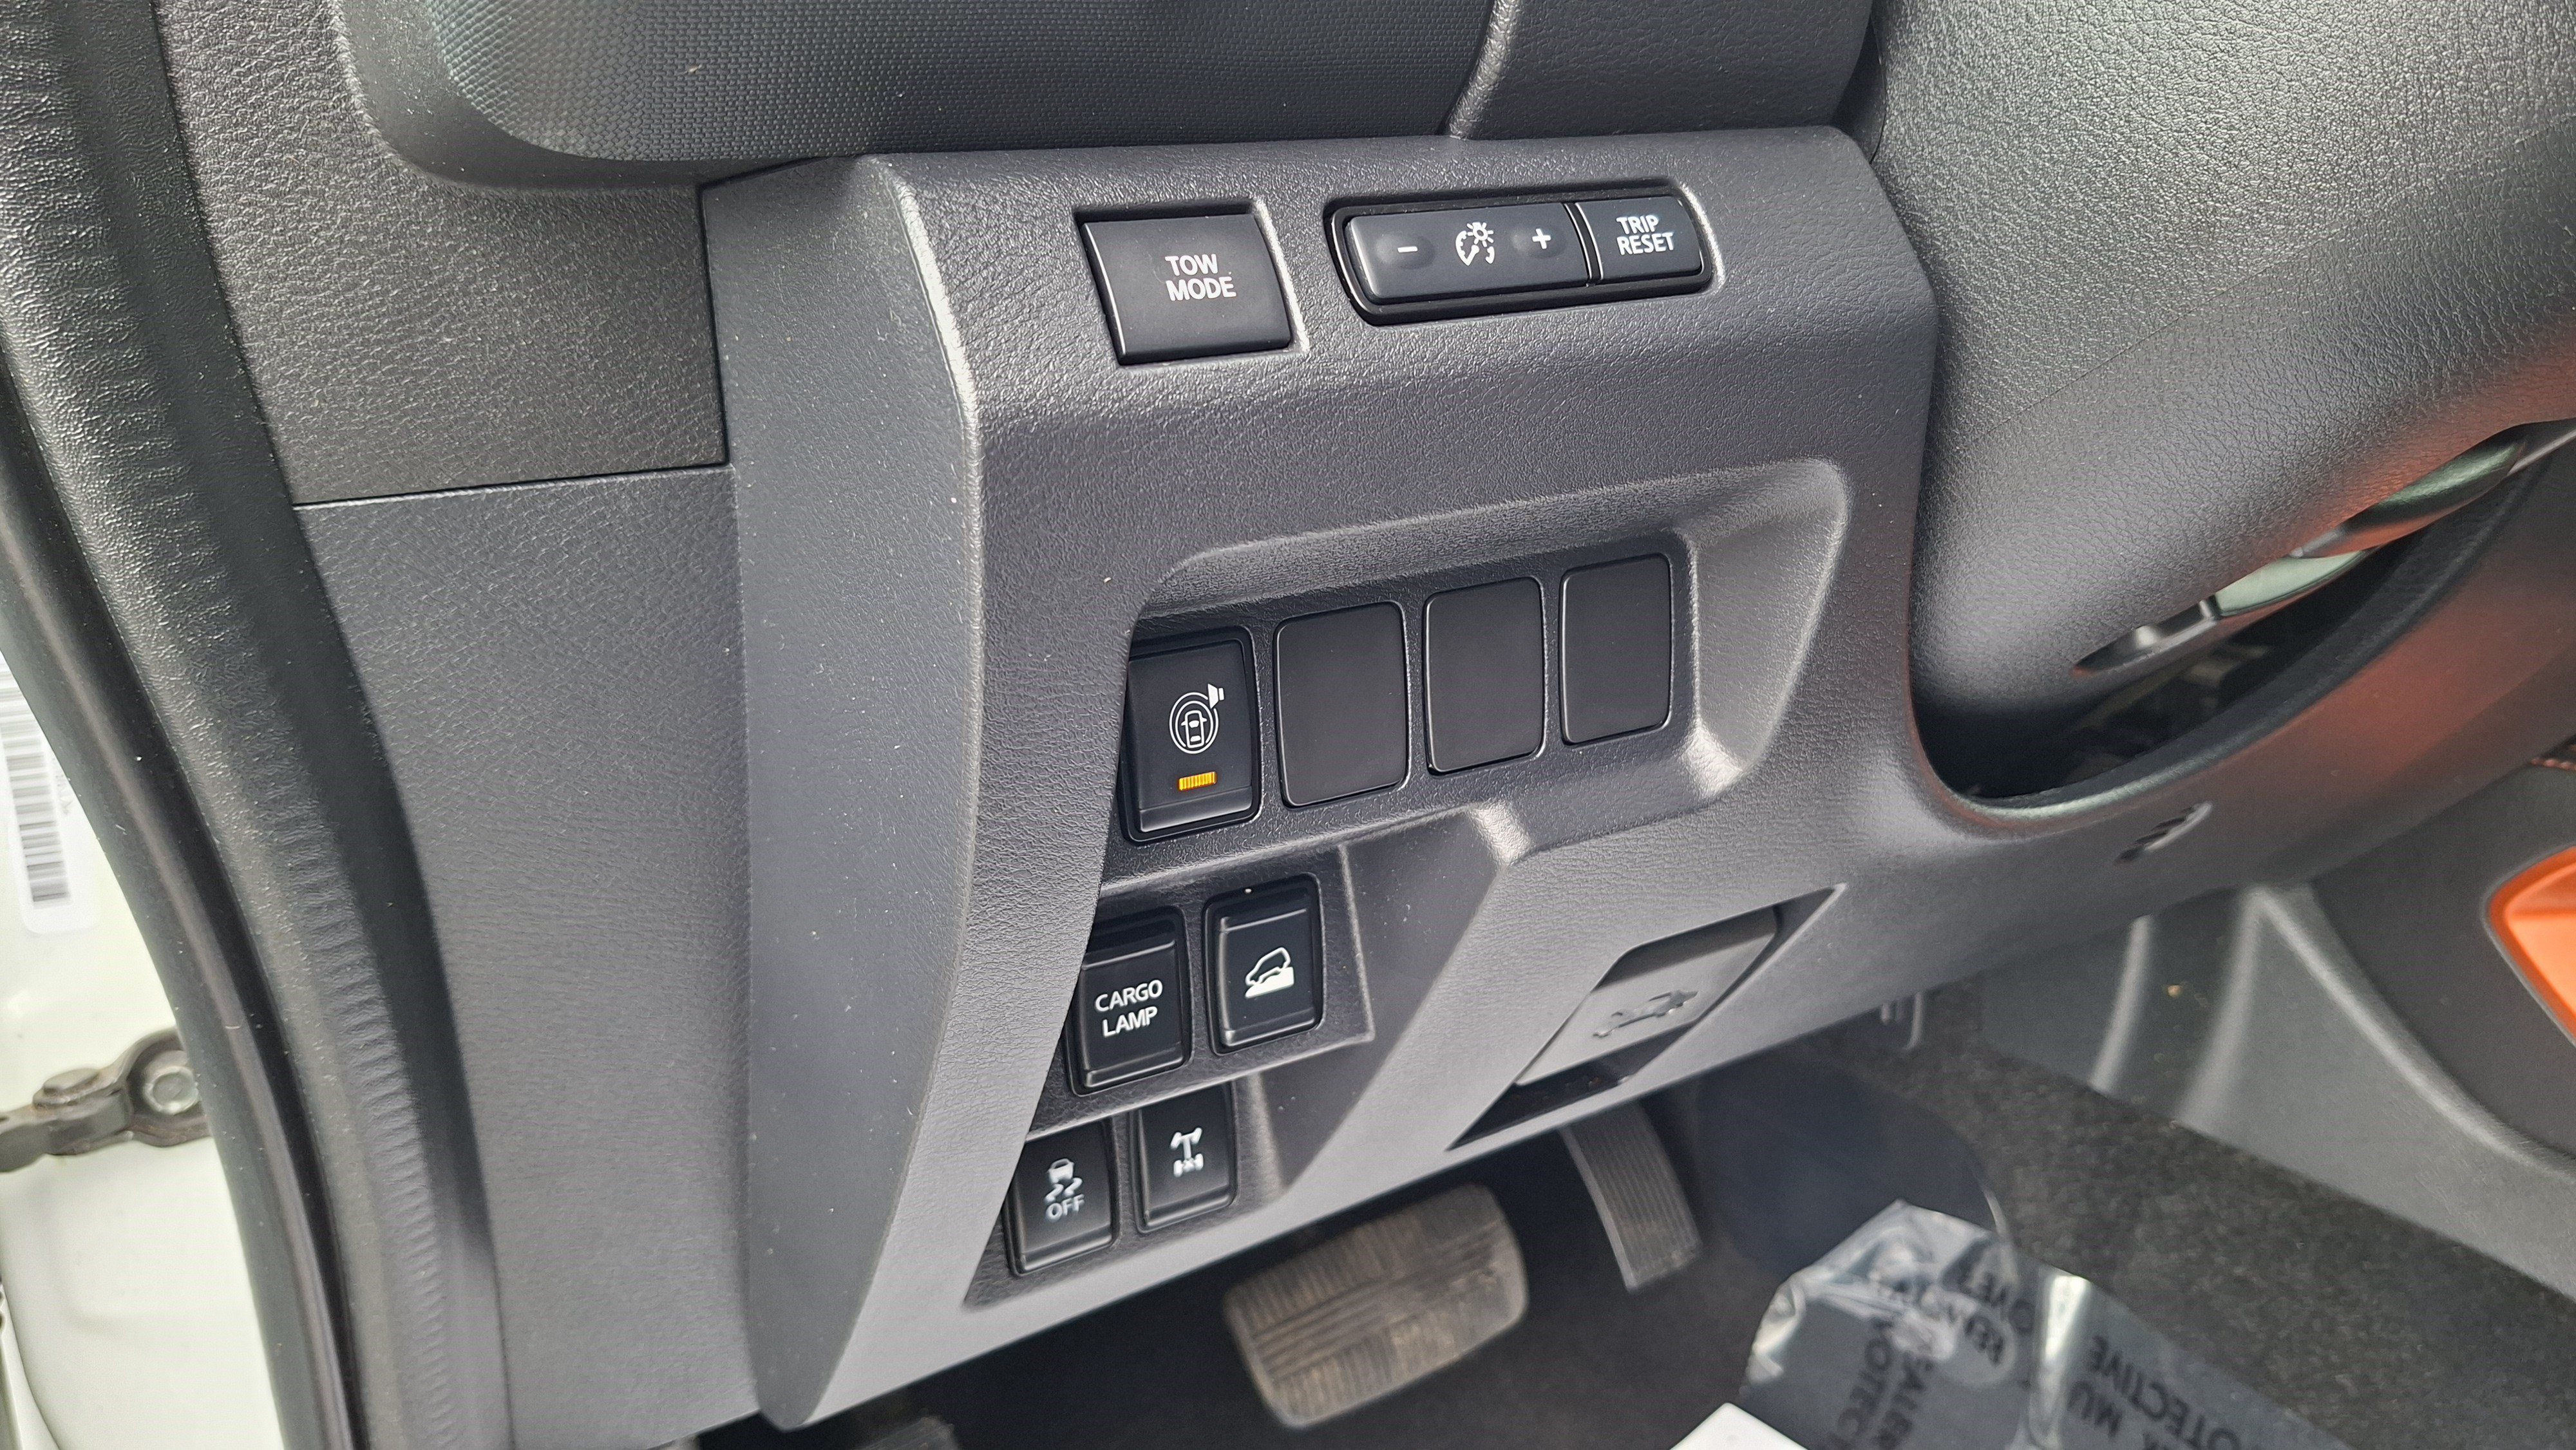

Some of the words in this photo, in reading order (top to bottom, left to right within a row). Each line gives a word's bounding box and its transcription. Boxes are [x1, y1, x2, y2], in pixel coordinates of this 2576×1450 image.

[1616, 214, 1659, 235] TRIP
[1616, 232, 1674, 256] RESET
[1164, 254, 1218, 276] TOW
[1166, 276, 1236, 301] MODE
[1095, 979, 1163, 1012] CARGO
[1103, 1006, 1158, 1037] LAMP
[1045, 1194, 1084, 1221] OFF
